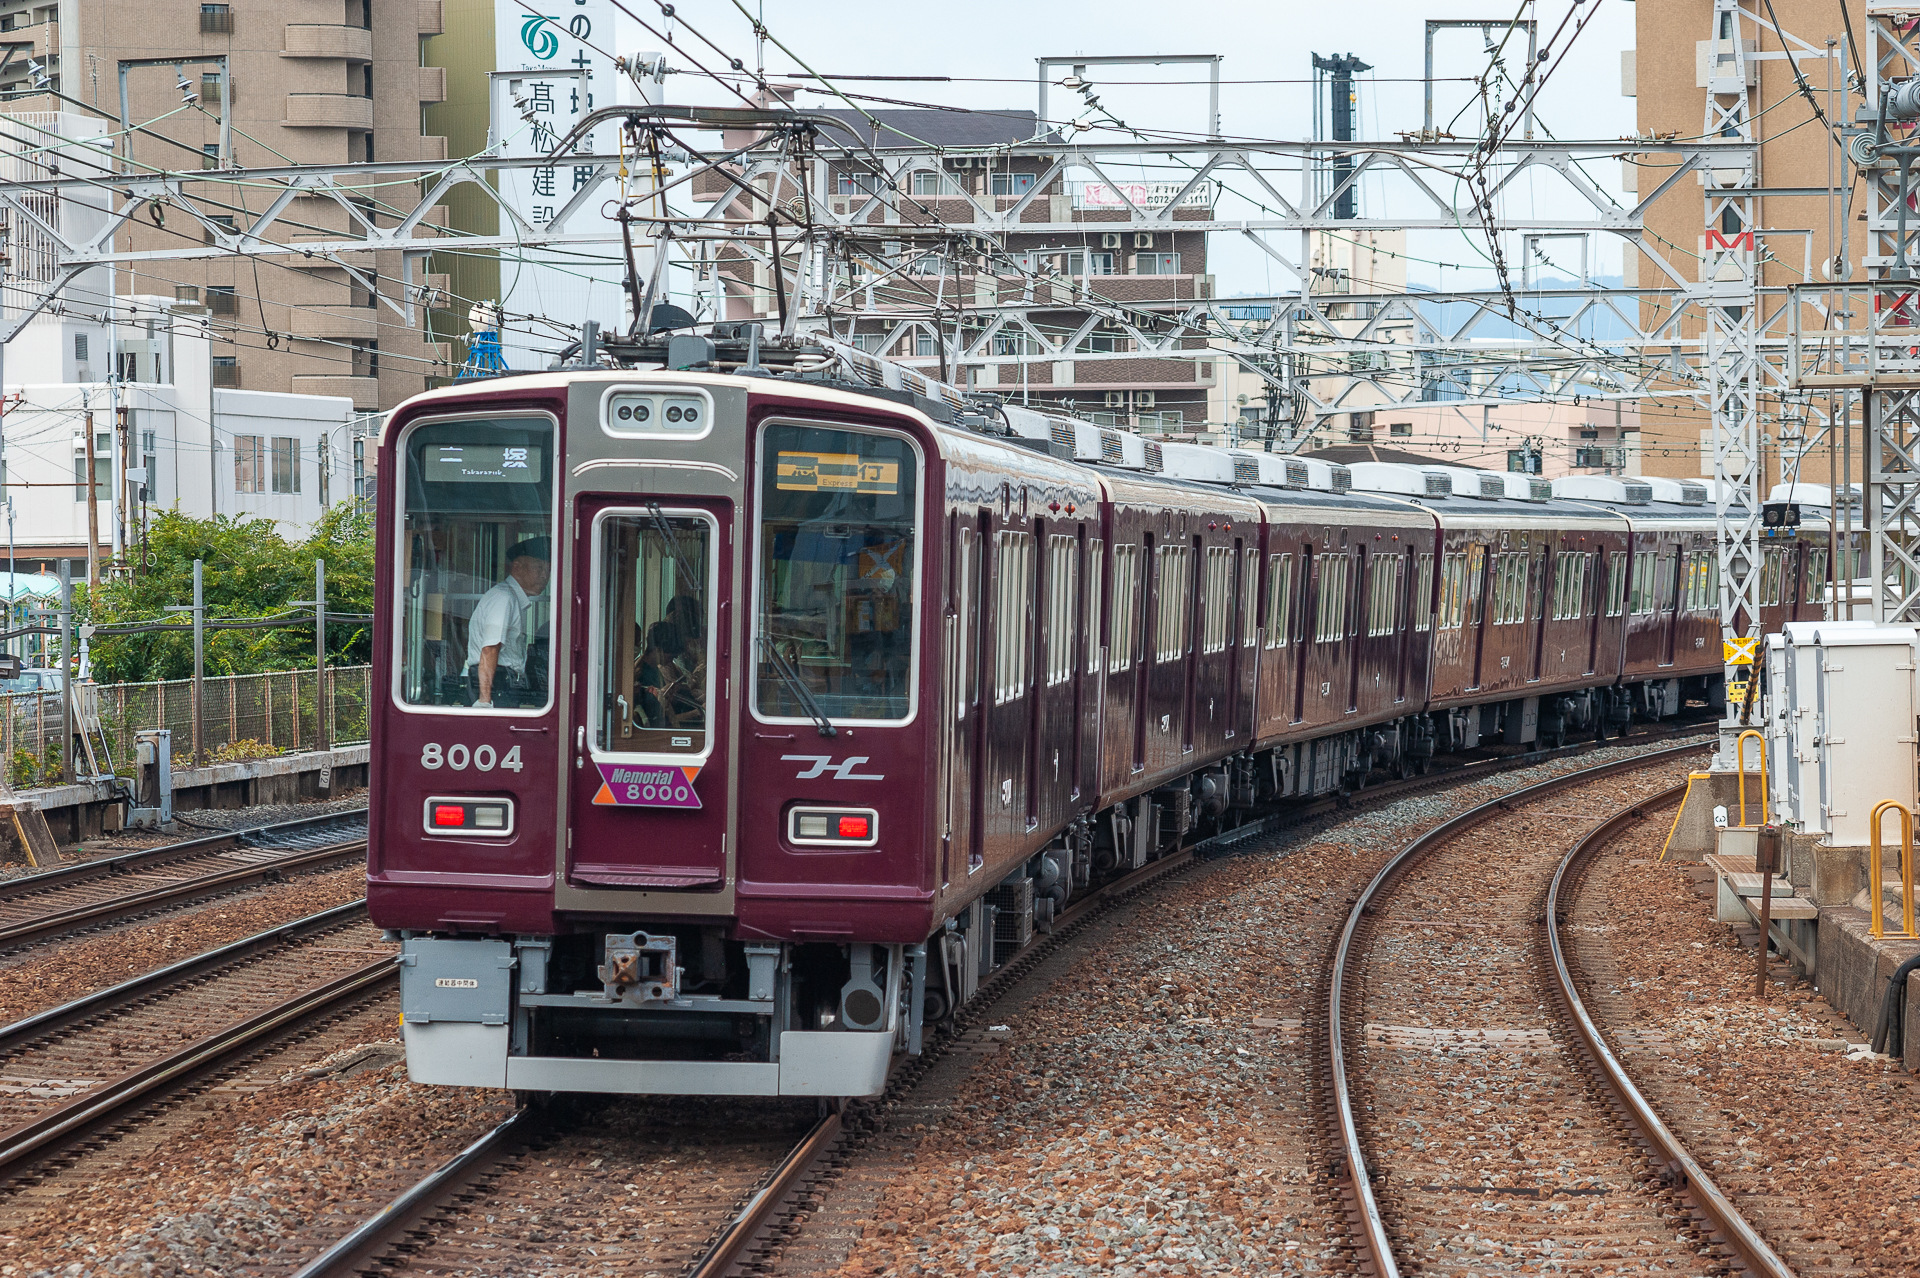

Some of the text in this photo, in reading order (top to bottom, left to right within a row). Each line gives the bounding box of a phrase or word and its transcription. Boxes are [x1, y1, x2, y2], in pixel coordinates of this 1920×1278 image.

[1154, 195, 1208, 204] 072-2-1111
[461, 469, 516, 477] Takarazuk
[822, 478, 853, 488] Express
[420, 742, 524, 773] 8004
[610, 768, 676, 786] Memorial
[626, 784, 689, 802] 8000
